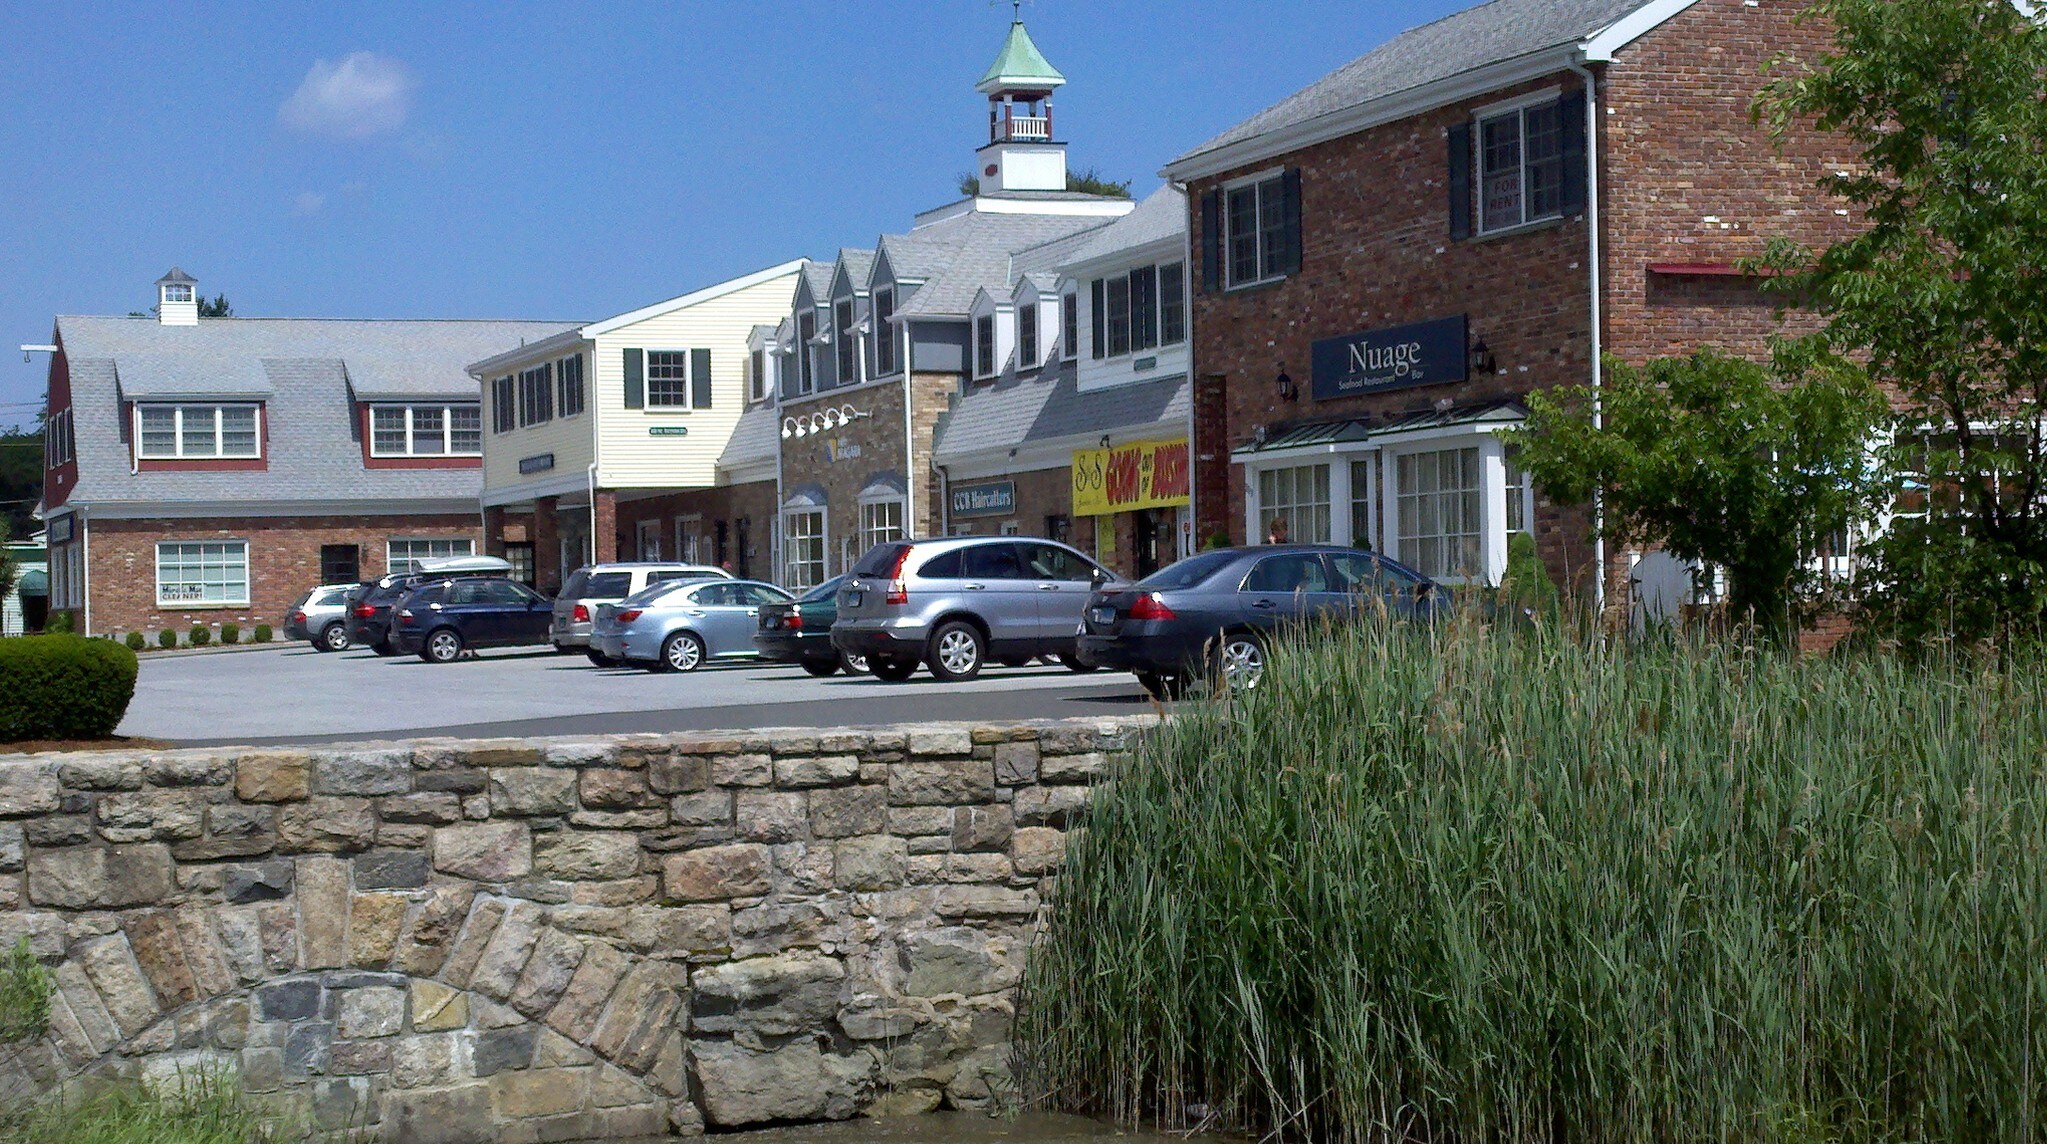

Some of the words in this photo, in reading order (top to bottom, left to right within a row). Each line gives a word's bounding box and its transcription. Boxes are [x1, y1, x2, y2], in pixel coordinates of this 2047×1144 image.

[1494, 178, 1517, 193] FOR
[1490, 194, 1519, 209] RENT
[1348, 341, 1421, 376] Nuage
[1338, 379, 1363, 390] Seafood
[1364, 374, 1395, 386] Restaurant
[1411, 369, 1424, 380] Bar
[1106, 447, 1141, 506] GOING
[1142, 476, 1150, 494] OF
[953, 491, 970, 511] CCB
[971, 489, 1011, 509] Haircutters
